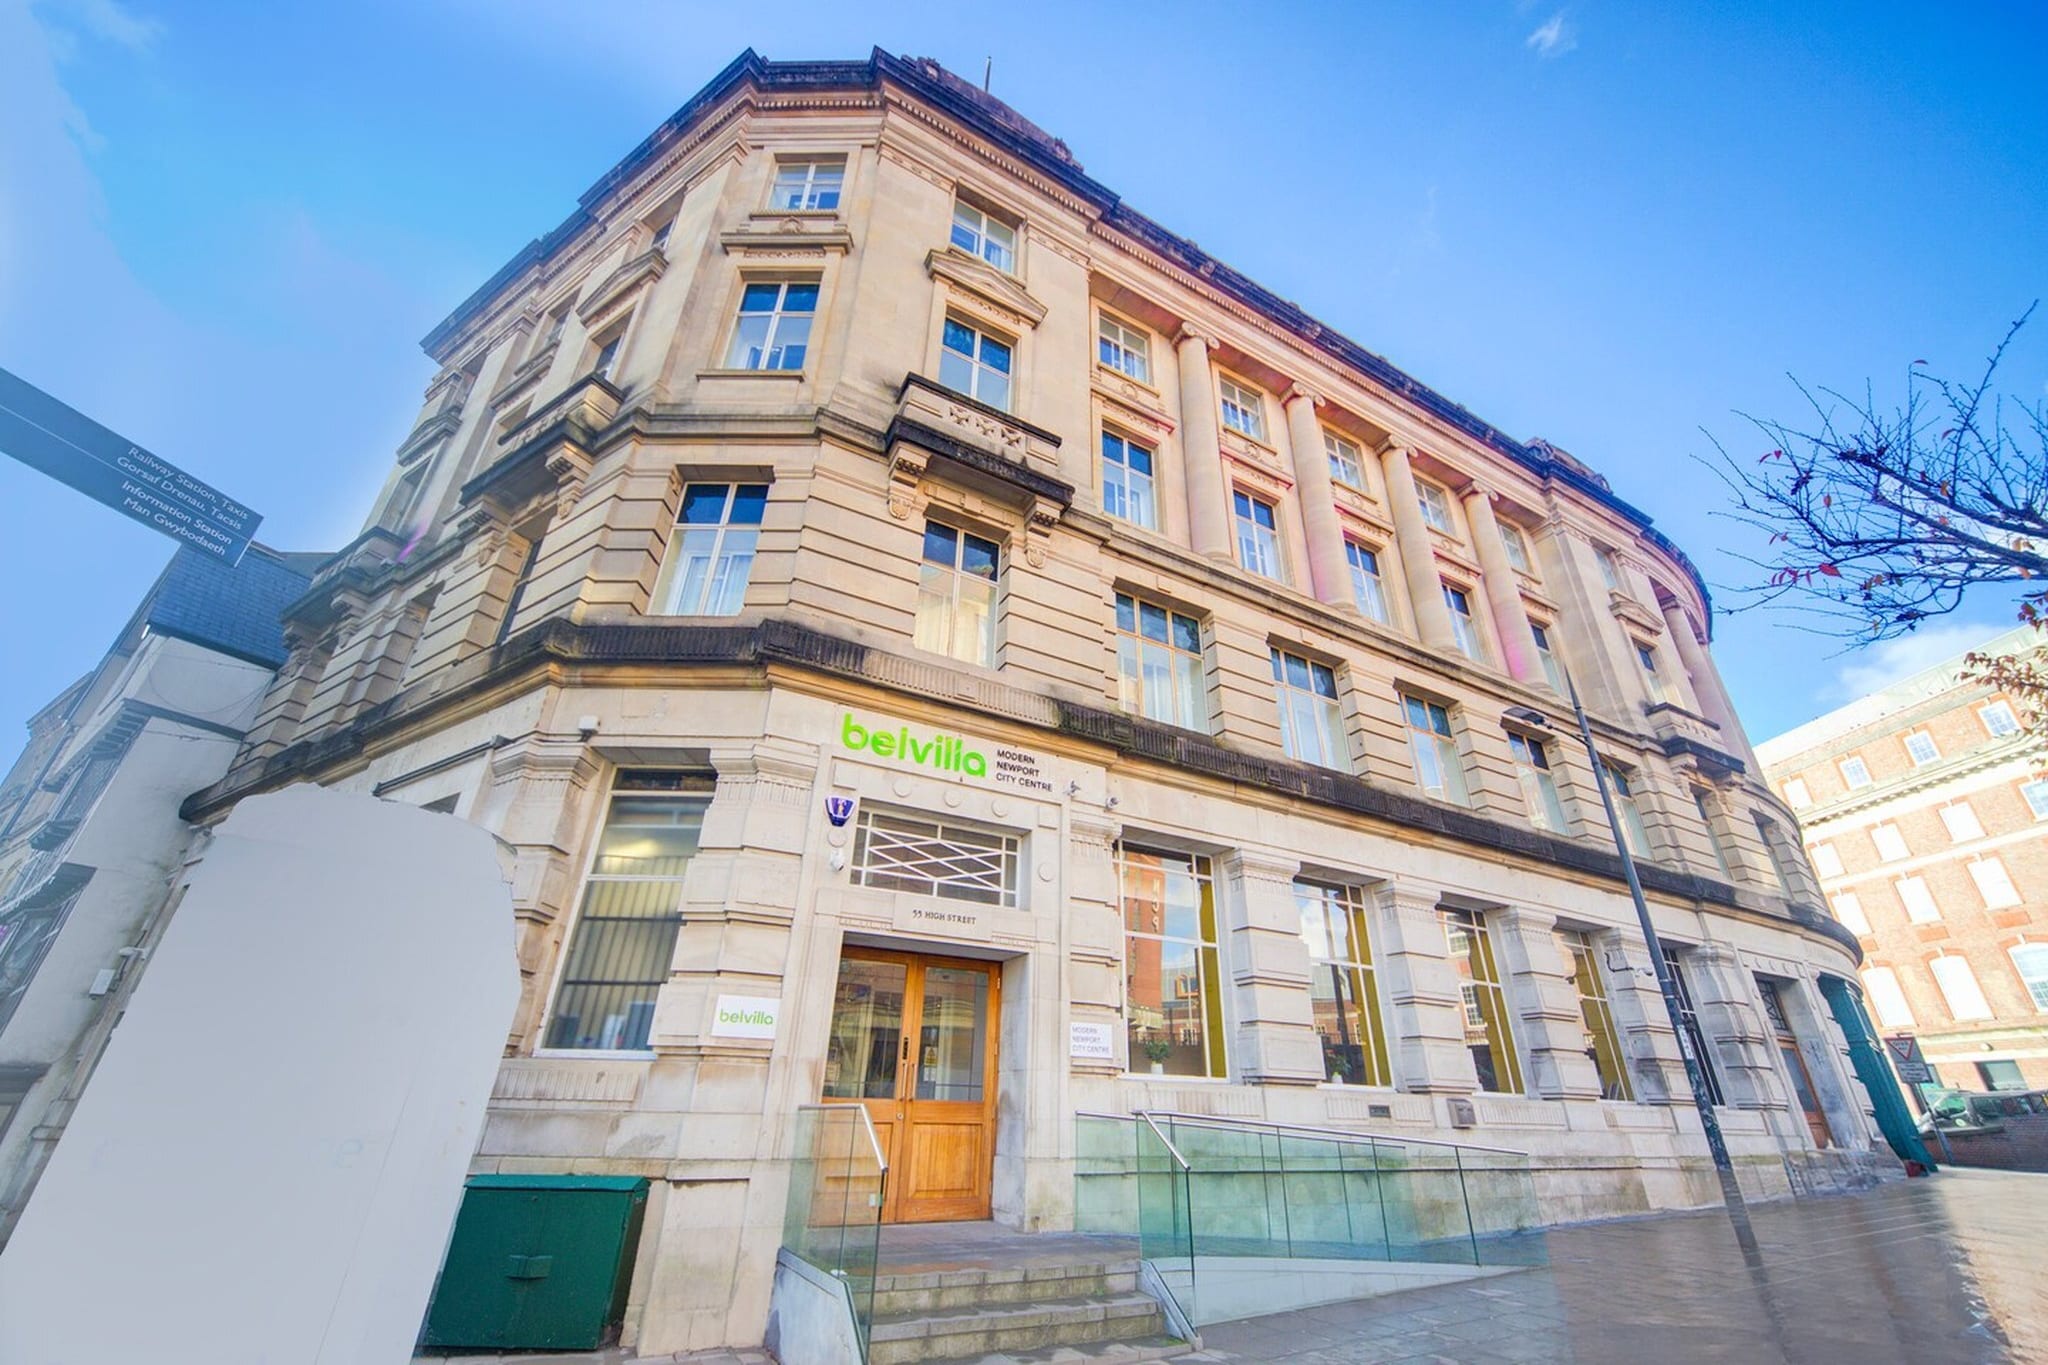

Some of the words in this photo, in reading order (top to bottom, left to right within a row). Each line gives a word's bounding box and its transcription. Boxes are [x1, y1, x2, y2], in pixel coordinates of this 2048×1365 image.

[117, 456, 161, 484] Gorsaf
[161, 481, 206, 512] Drenau,
[211, 506, 241, 530] Tacsis
[128, 447, 175, 478] Railway
[176, 474, 217, 503] Station,
[222, 498, 249, 520] Taxis
[122, 481, 192, 523] Information
[194, 519, 233, 545] Station
[124, 497, 151, 517] Man
[154, 513, 226, 556] Gwybodaeth
[841, 713, 987, 777] belvilla
[997, 749, 1035, 764] MODERN
[996, 761, 1040, 777] NEWPORT
[996, 772, 1016, 784] CITY
[1018, 777, 1053, 792] CENTRE
[924, 911, 945, 921] HIGH
[946, 913, 977, 925] STREET
[719, 1007, 774, 1025] belvilla
